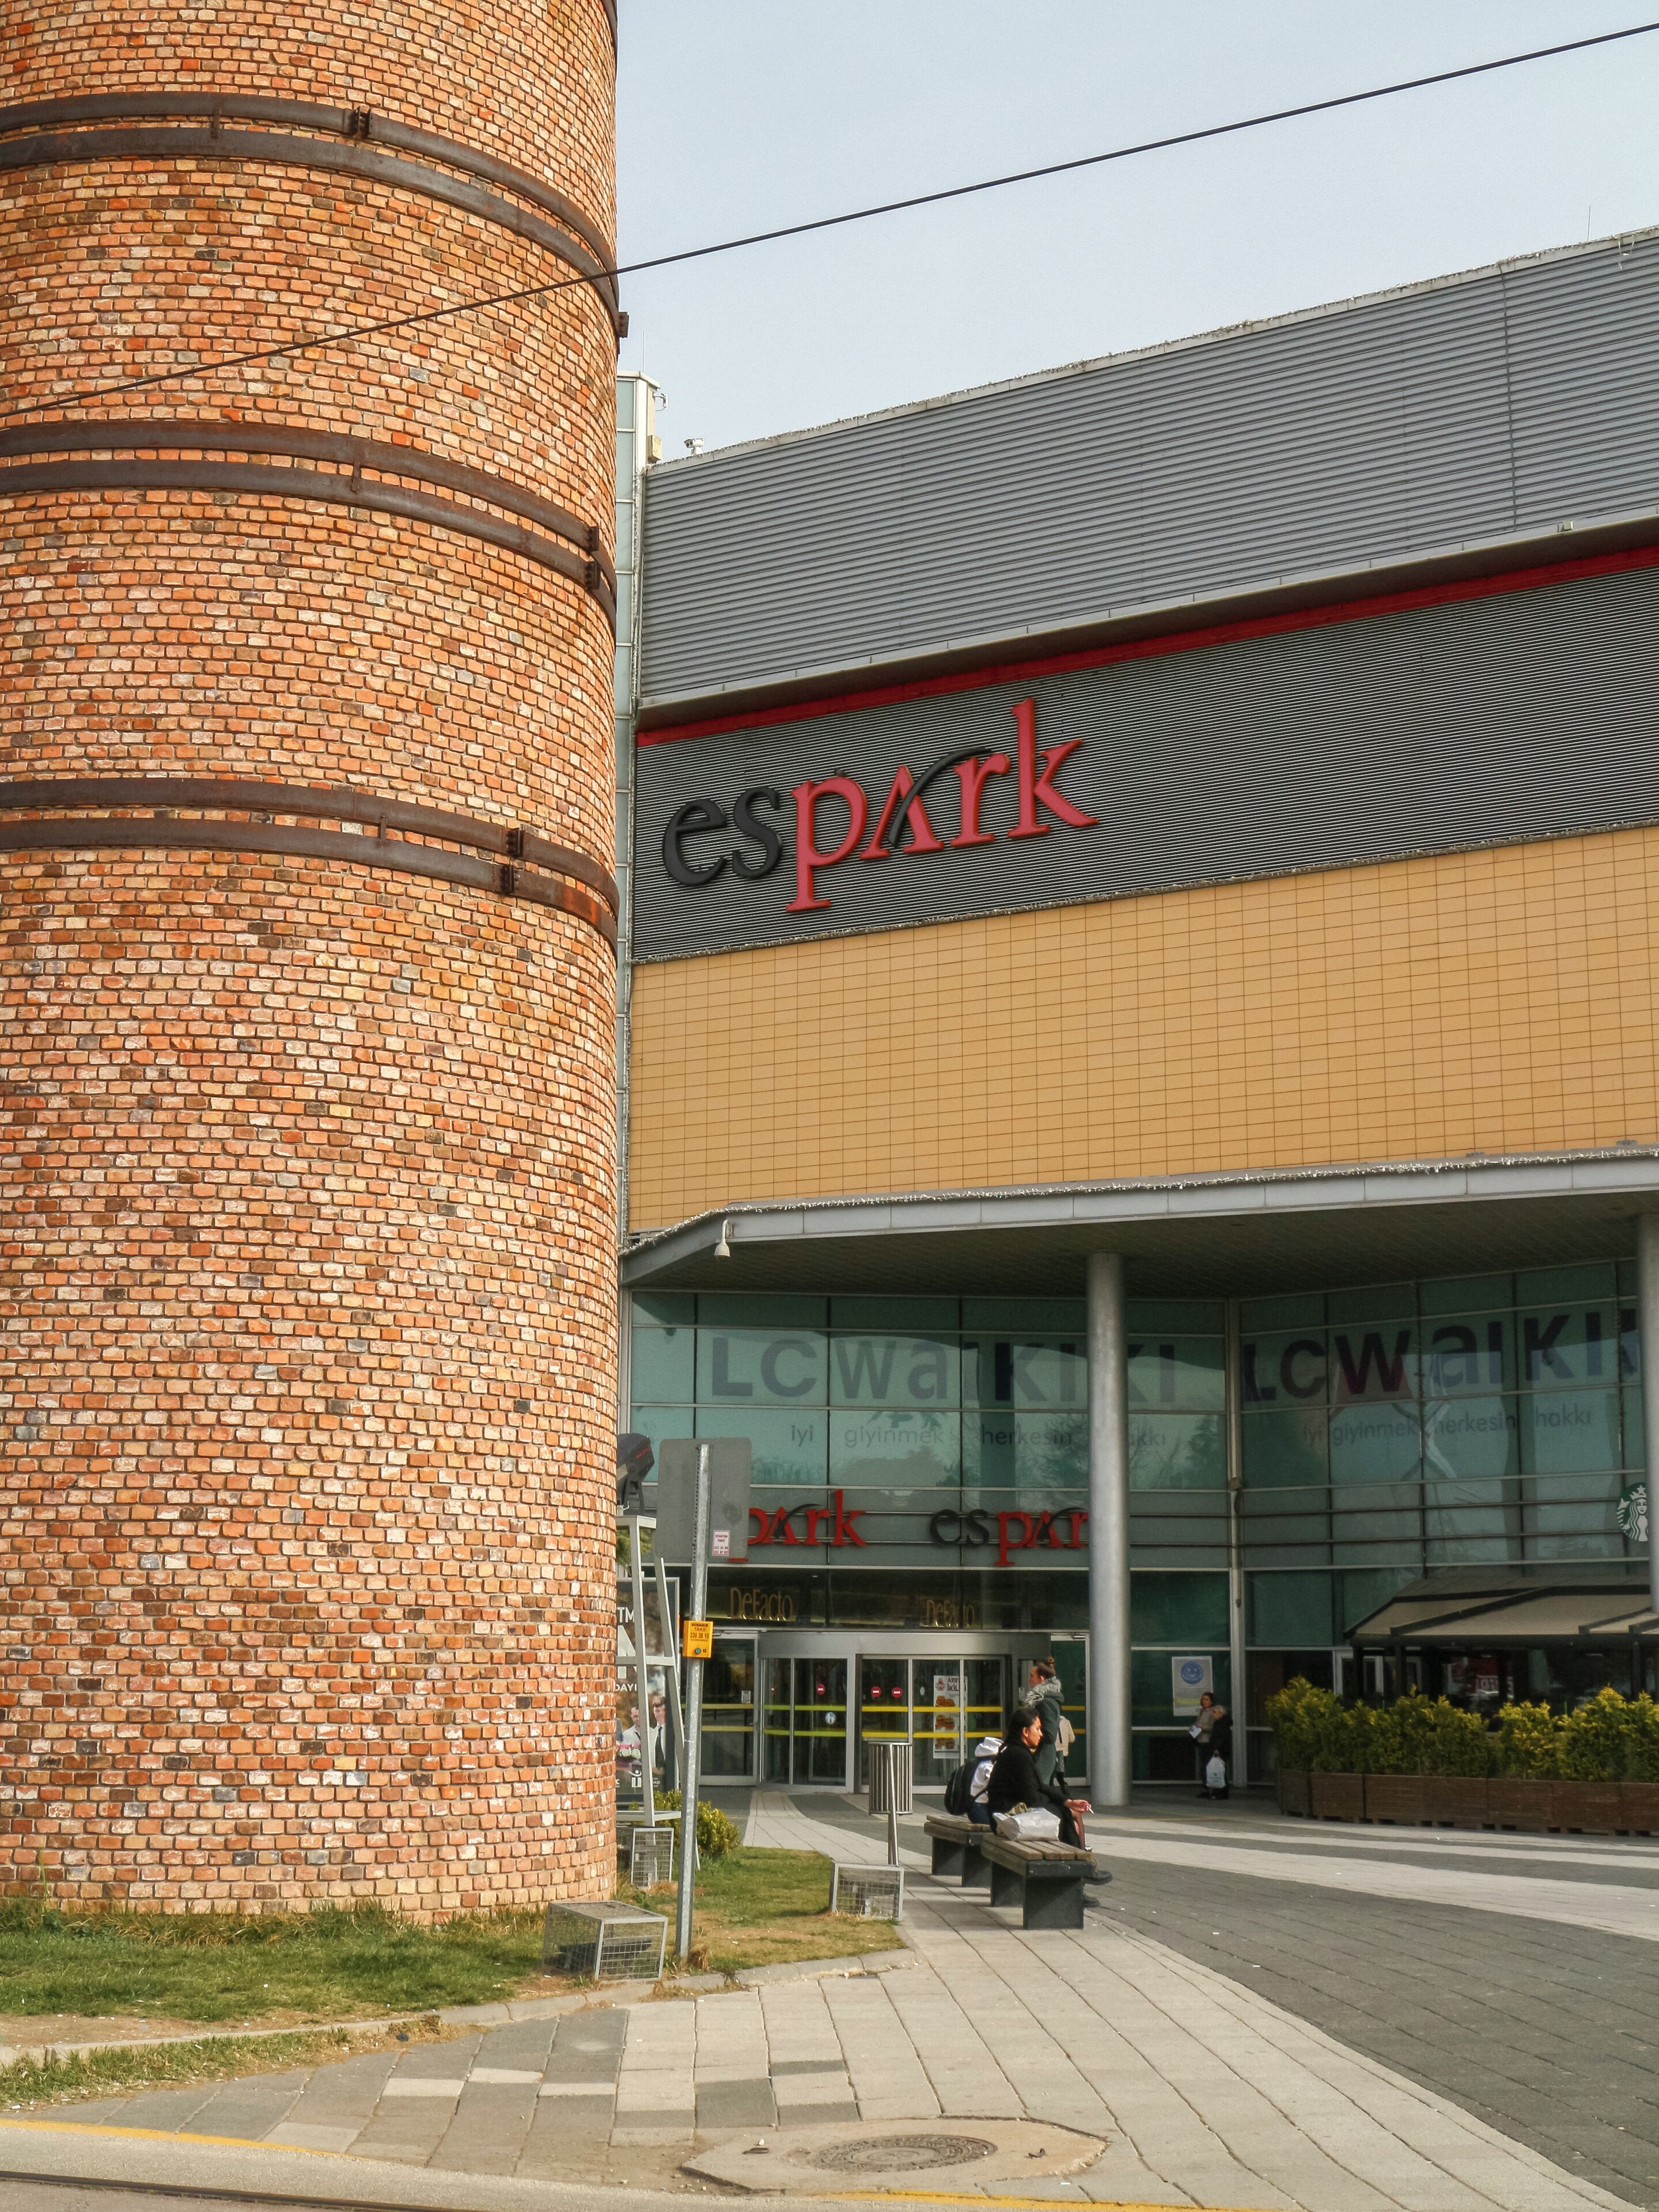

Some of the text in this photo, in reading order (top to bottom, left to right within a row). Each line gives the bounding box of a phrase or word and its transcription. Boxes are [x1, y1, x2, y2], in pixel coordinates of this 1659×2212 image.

[662, 698, 1099, 912] espark
[791, 1425, 814, 1448] iyi
[844, 1425, 943, 1448] giyinmek
[982, 1425, 1072, 1445] herkesin
[1304, 1425, 1322, 1448] iyi
[1332, 1419, 1418, 1446] giyinmek
[1433, 1409, 1517, 1436] herkesin
[730, 1588, 793, 1620] DeFacto
